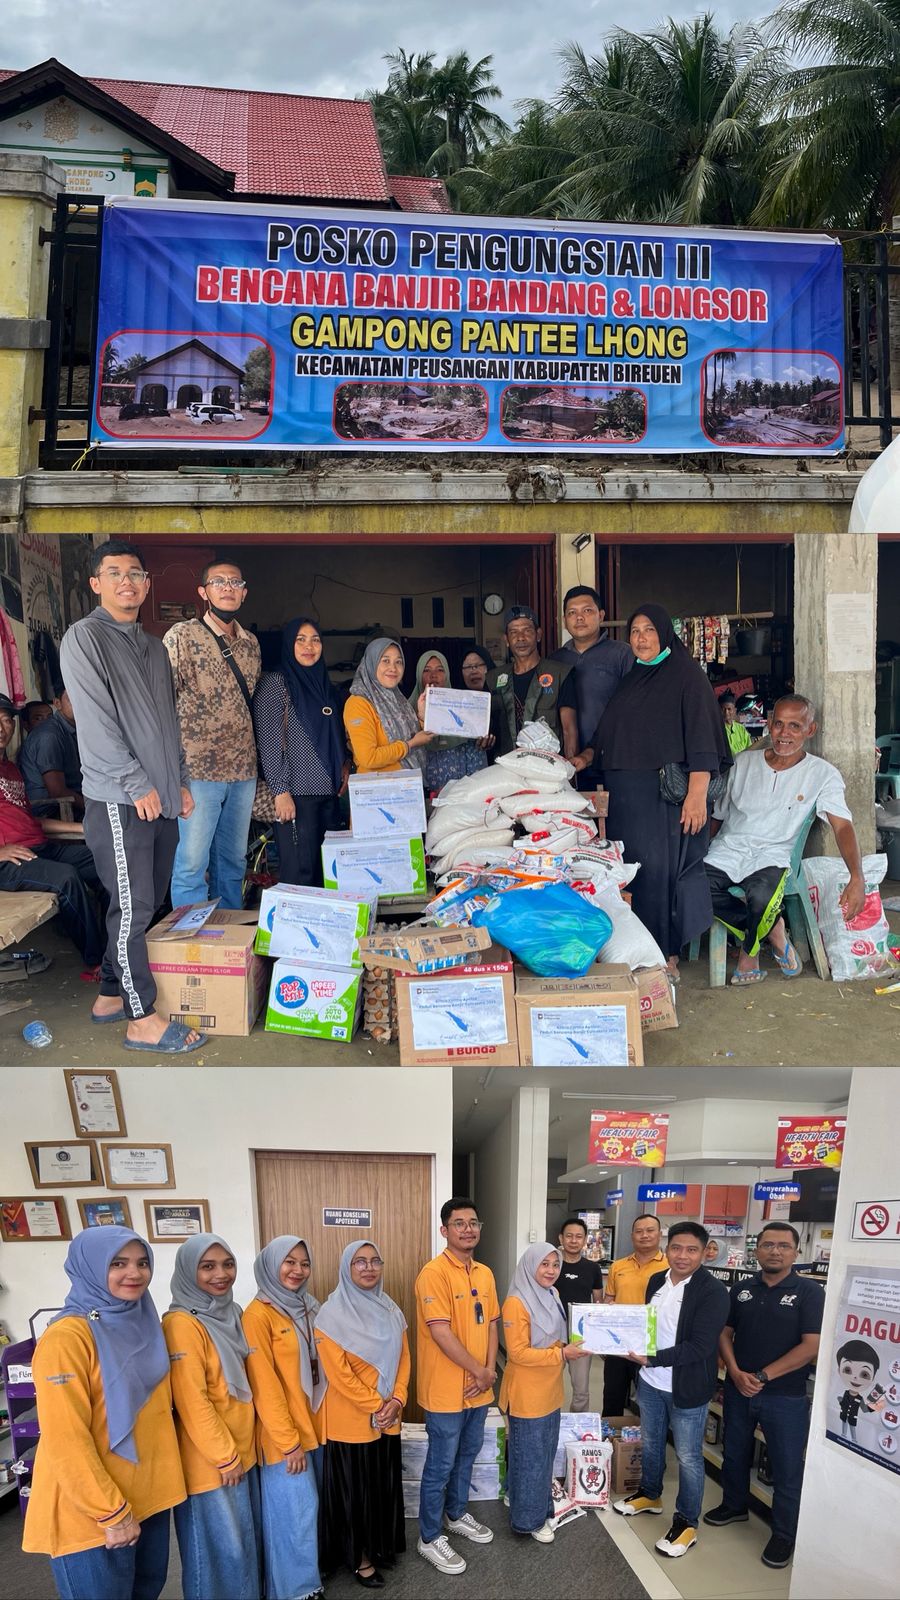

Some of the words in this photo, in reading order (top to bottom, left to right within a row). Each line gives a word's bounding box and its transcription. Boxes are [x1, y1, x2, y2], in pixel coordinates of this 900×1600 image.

[267, 224, 398, 267] POSKO
[410, 231, 664, 278] PENGUNGSIAN
[676, 244, 711, 280] III
[197, 266, 348, 308] BENCANA
[354, 273, 462, 311] BANJIR
[467, 278, 606, 317] BANDANG
[612, 288, 635, 318] &
[640, 286, 768, 322] LONGSOR
[292, 314, 452, 352] GAMPONG
[460, 319, 578, 355] PANTEE
[586, 323, 688, 359] LHONG
[295, 355, 404, 378] KECAMATAN
[407, 358, 510, 380] PEUSANGAN
[513, 360, 609, 382] KABUPATEN
[613, 363, 682, 384] BIREUEN
[280, 981, 299, 994] POP
[284, 989, 305, 1003] MIE
[314, 989, 334, 998] TIME
[457, 1046, 496, 1055] Bunda
[600, 1128, 635, 1138] HEALTH
[636, 1129, 659, 1139] FAIR
[785, 1133, 818, 1142] HEALTH
[818, 1131, 839, 1141] FAIR
[606, 1146, 619, 1155] 50
[790, 1150, 802, 1158] 50
[757, 1184, 798, 1193] Penyerahan
[646, 1189, 676, 1199] Kasir
[769, 1192, 785, 1200] Obat
[325, 1210, 342, 1218] RUANG
[343, 1210, 369, 1219] KONSELING
